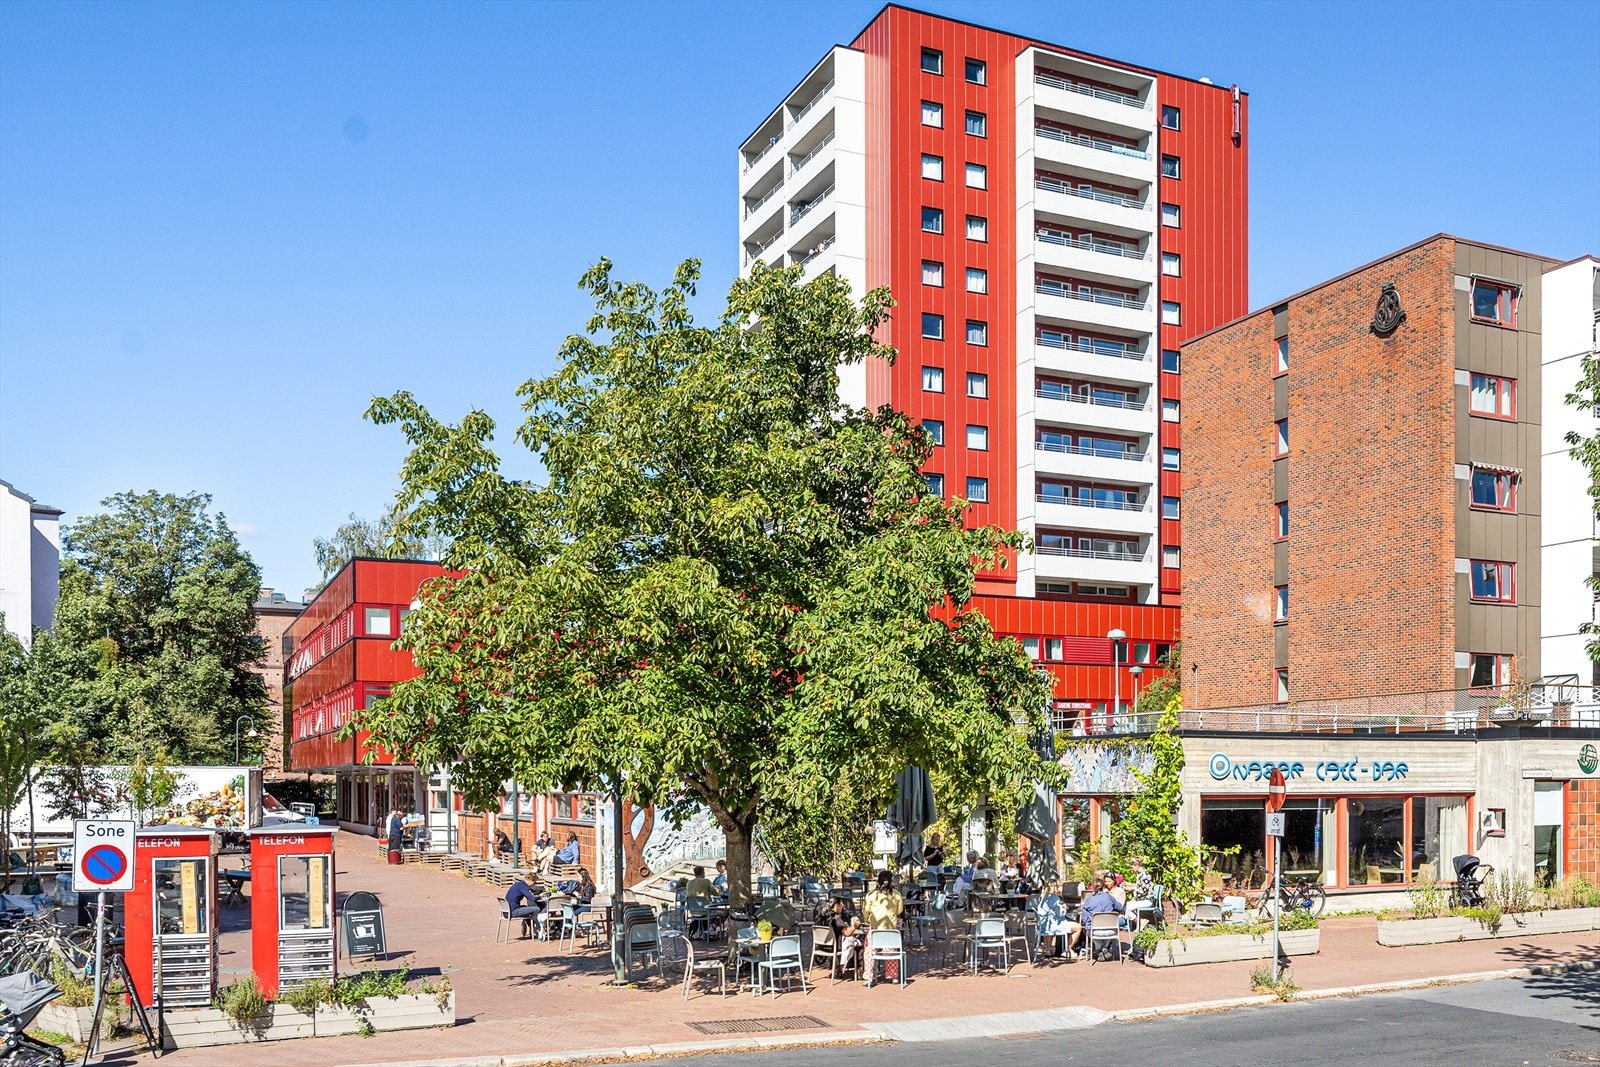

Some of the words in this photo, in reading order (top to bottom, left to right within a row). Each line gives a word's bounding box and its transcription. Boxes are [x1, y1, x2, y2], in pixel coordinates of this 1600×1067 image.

[86, 824, 125, 837] Sone
[137, 838, 180, 848] ELEFON
[258, 835, 304, 846] TELEFON
